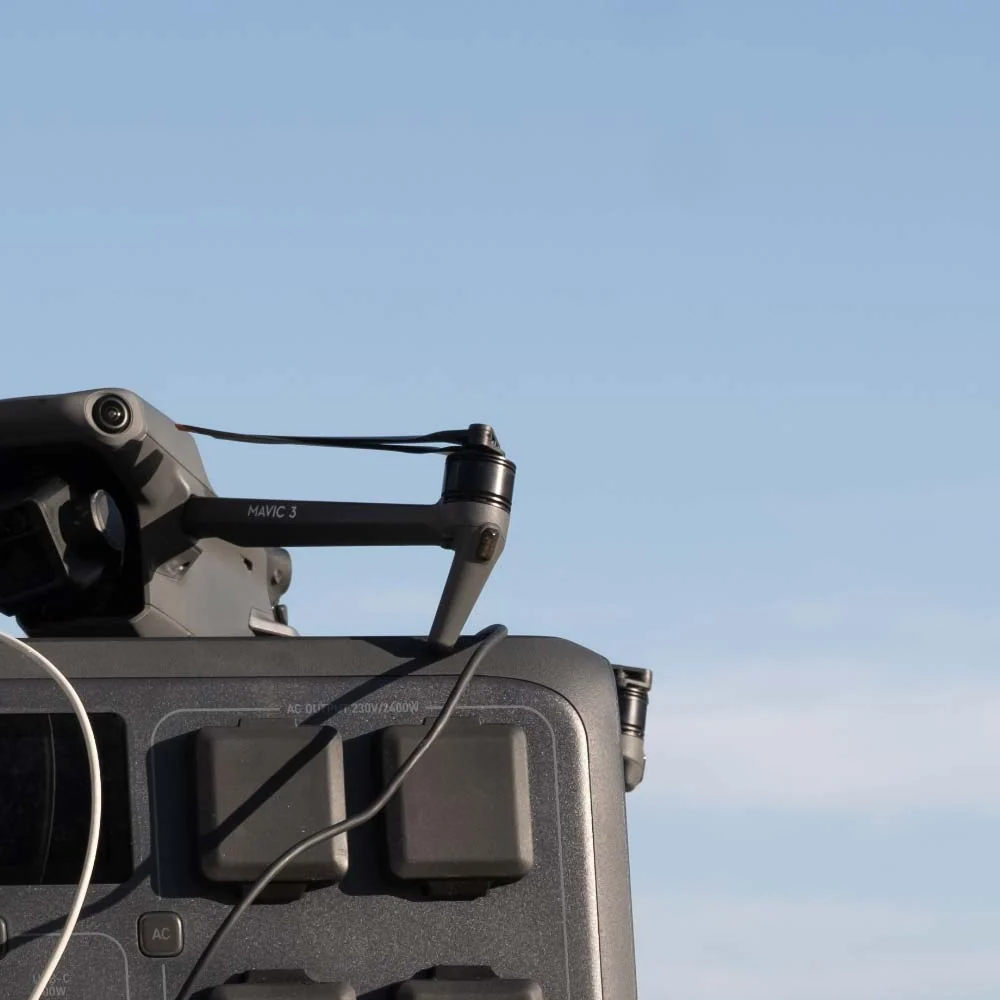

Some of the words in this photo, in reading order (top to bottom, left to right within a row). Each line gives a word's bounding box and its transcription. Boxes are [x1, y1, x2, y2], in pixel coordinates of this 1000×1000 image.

[247, 504, 285, 519] MAVIC
[289, 504, 298, 519] 3
[286, 703, 302, 714] AC
[351, 701, 420, 714] 230V/2400W
[151, 927, 171, 941] AC
